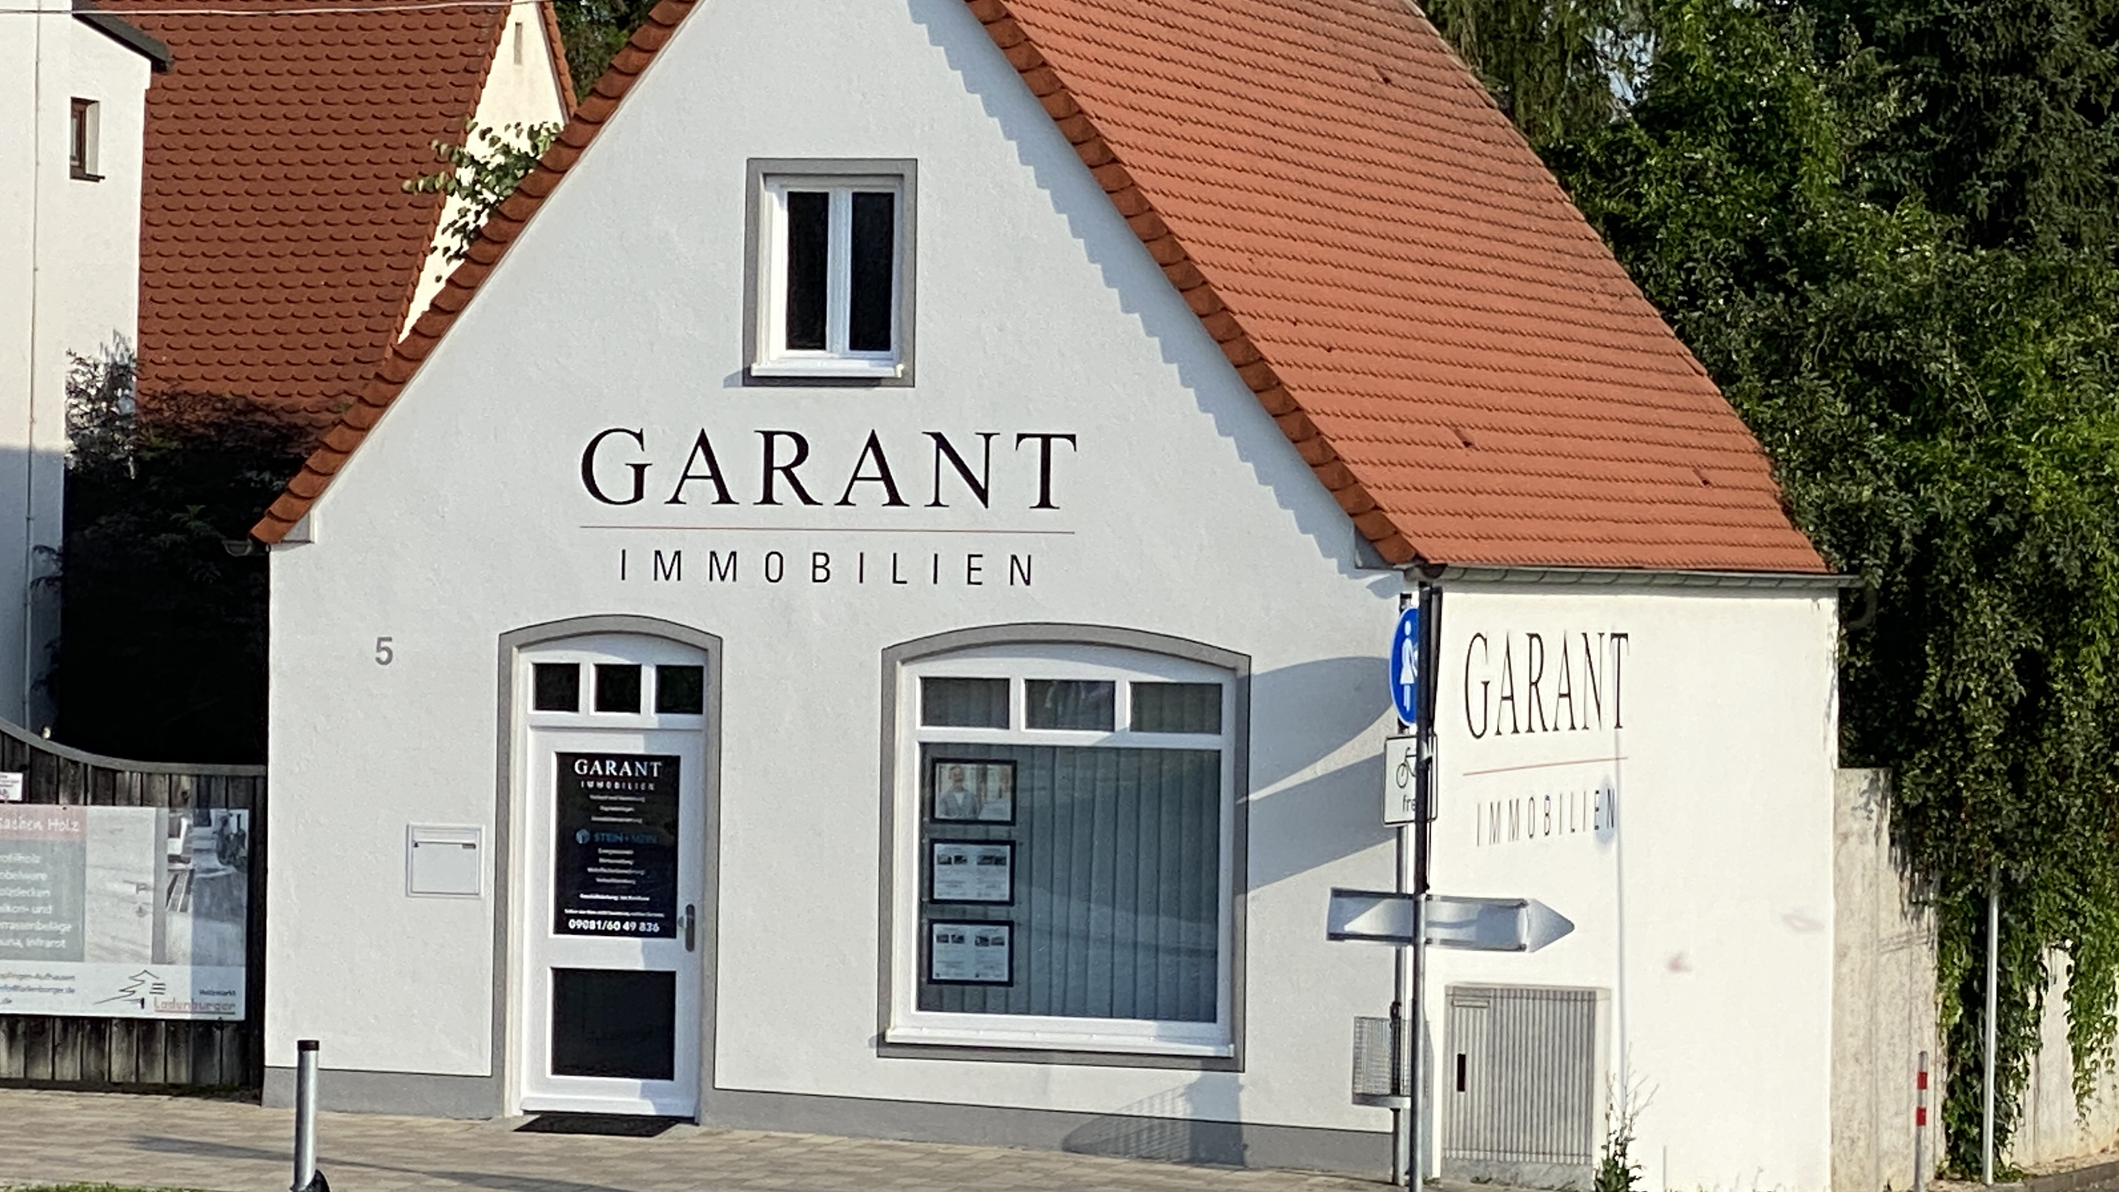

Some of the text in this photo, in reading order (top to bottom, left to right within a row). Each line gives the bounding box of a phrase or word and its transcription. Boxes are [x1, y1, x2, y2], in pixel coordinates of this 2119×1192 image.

[581, 427, 1077, 510] GARANT
[620, 549, 1033, 586] IMMOBILIEN
[375, 636, 393, 666] 5
[1464, 631, 1629, 739] GARANT
[574, 758, 662, 777] GARANT
[580, 780, 655, 791] IMMOBILIEN
[47, 817, 80, 832] Holz
[1476, 788, 1615, 847] IMMOBILIEN
[568, 919, 621, 931] 09081/60
